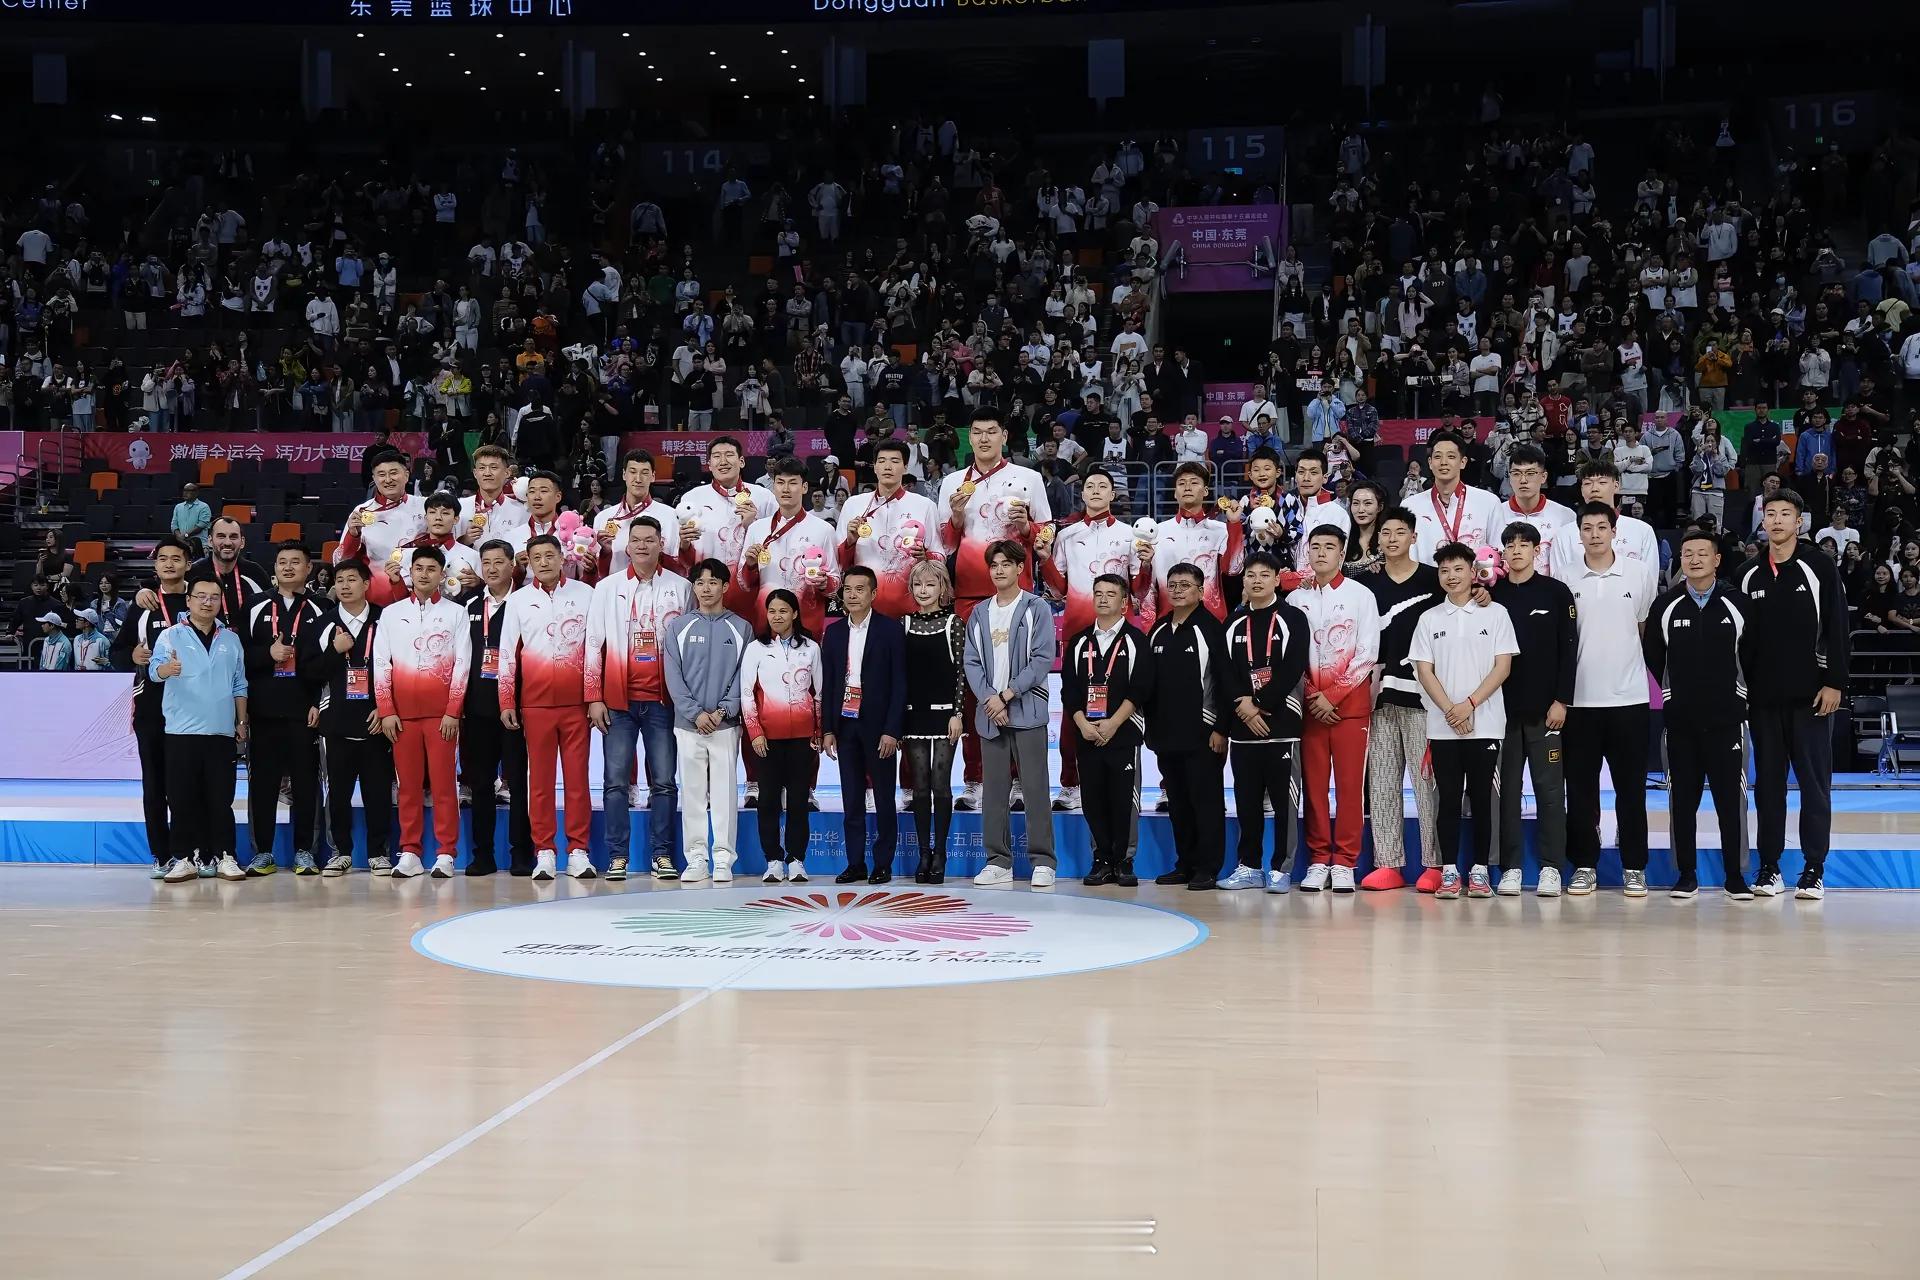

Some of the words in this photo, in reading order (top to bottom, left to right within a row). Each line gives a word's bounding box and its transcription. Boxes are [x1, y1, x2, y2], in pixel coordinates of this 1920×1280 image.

[814, 0, 945, 13] Dongguan
[1784, 100, 1856, 129] 116
[1202, 134, 1265, 161] 115
[662, 149, 722, 175] 114
[1192, 228, 1247, 241] 中国·东莞
[169, 444, 265, 462] 激情全运会
[662, 439, 710, 452] 精彩全运
